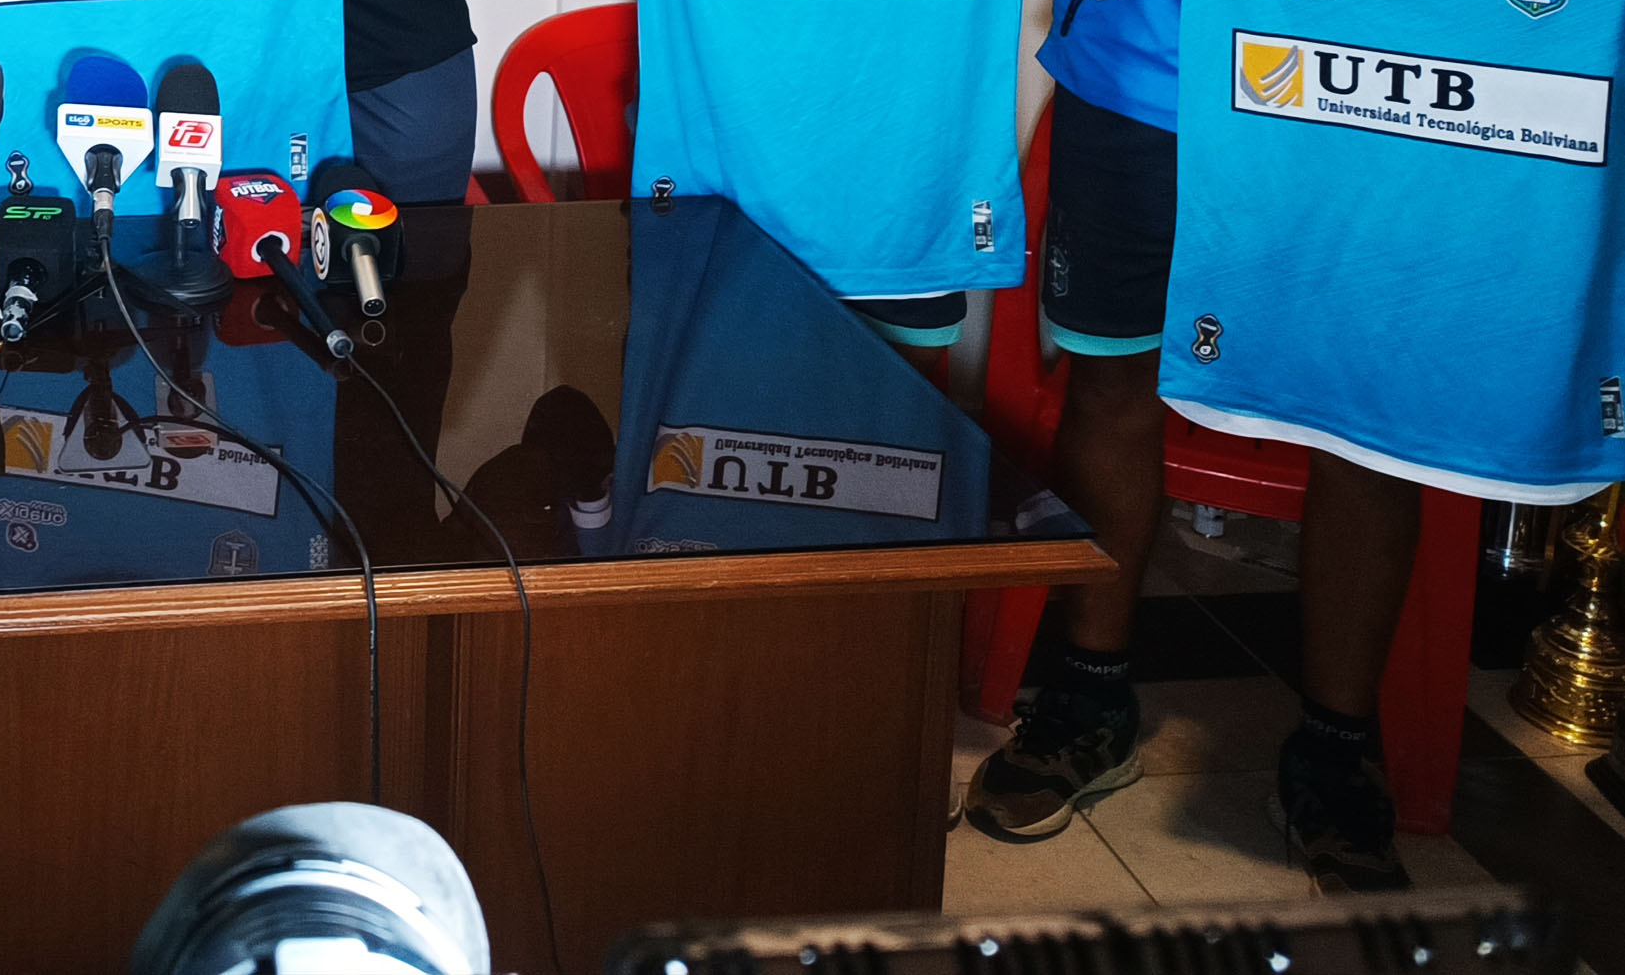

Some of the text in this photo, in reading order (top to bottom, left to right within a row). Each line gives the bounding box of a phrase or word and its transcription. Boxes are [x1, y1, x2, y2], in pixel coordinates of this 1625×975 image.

[1314, 49, 1476, 112] UTB
[97, 118, 143, 128] SPORTS
[1317, 97, 1598, 153] Universidad Tecnológica Boliviana
[230, 183, 285, 197] FUTBOL
